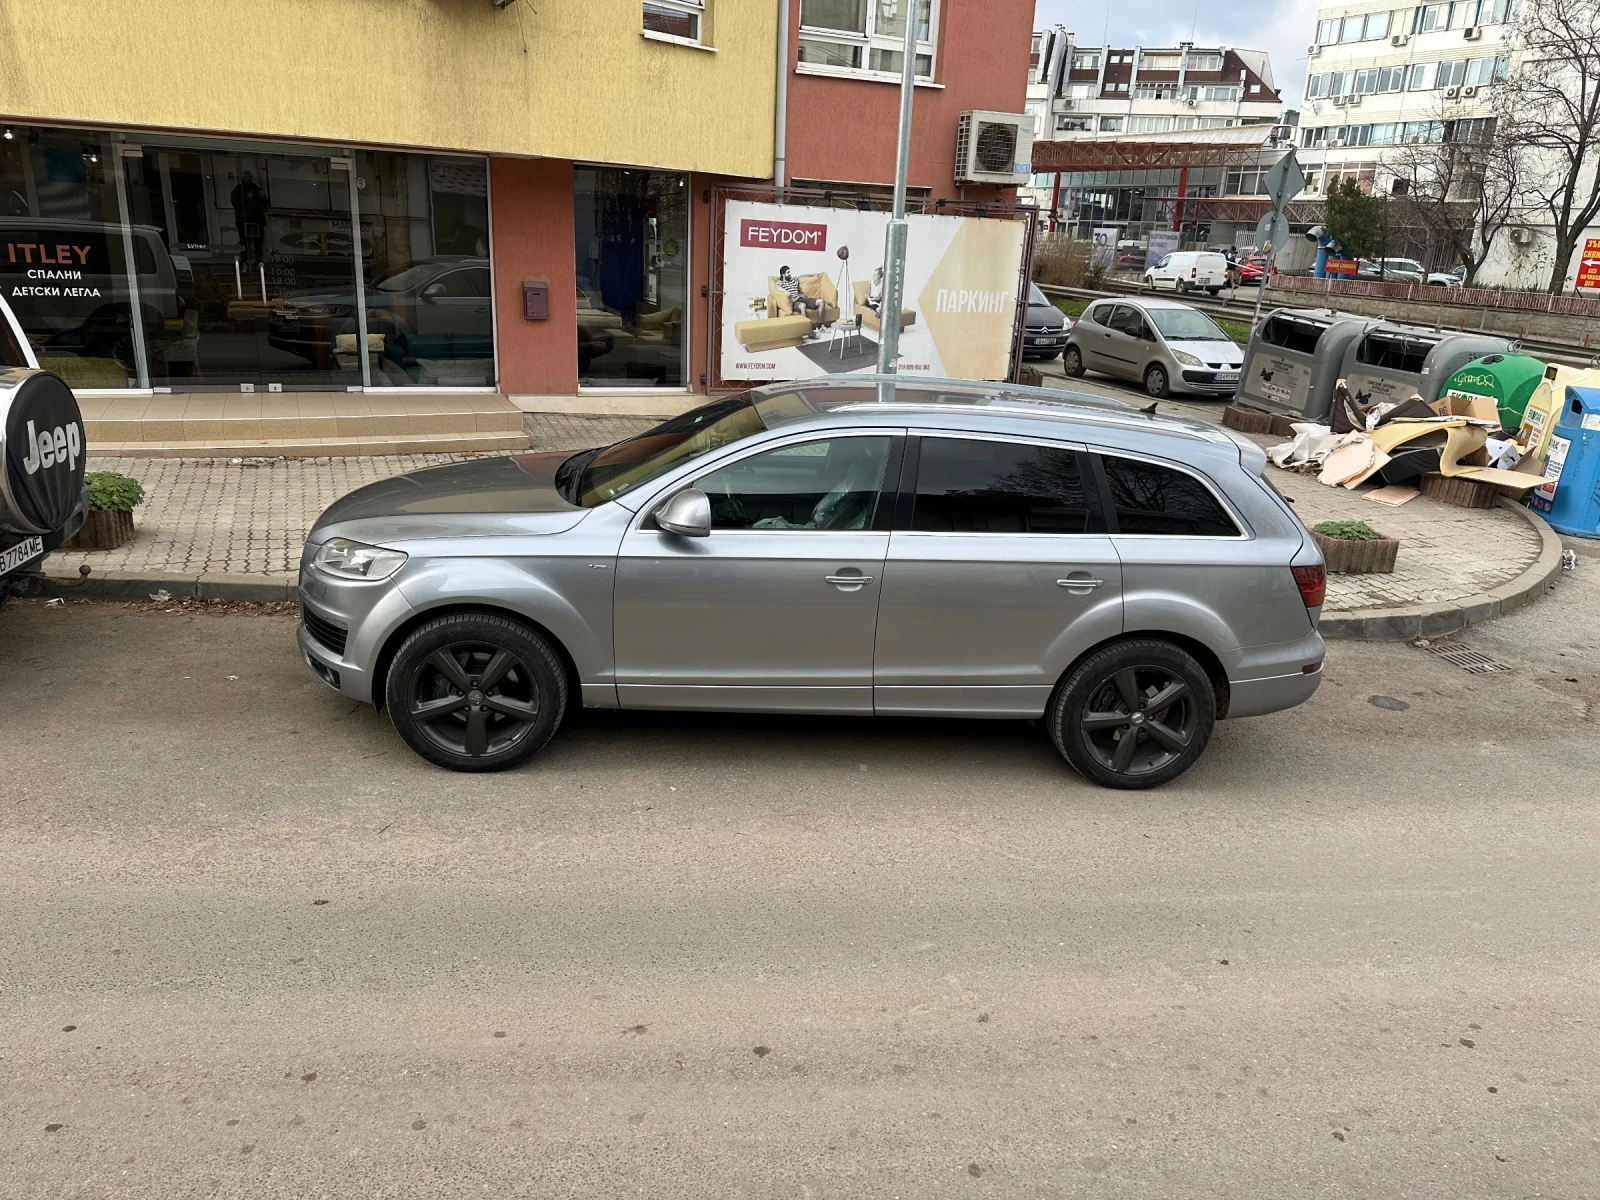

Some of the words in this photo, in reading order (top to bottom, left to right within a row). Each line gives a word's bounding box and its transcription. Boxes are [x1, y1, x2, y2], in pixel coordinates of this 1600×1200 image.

[8, 243, 91, 265] ITLEY
[270, 255, 295, 264] 19:00
[27, 269, 82, 280] СПАЛНИ
[271, 268, 296, 276] 10:00
[272, 277, 297, 285] 18:00
[12, 286, 60, 297] ДЕТСКИ
[63, 287, 101, 298] ЛЕГЛА
[936, 289, 1009, 313] ПАРКИНГ
[23, 420, 80, 474] Jeep
